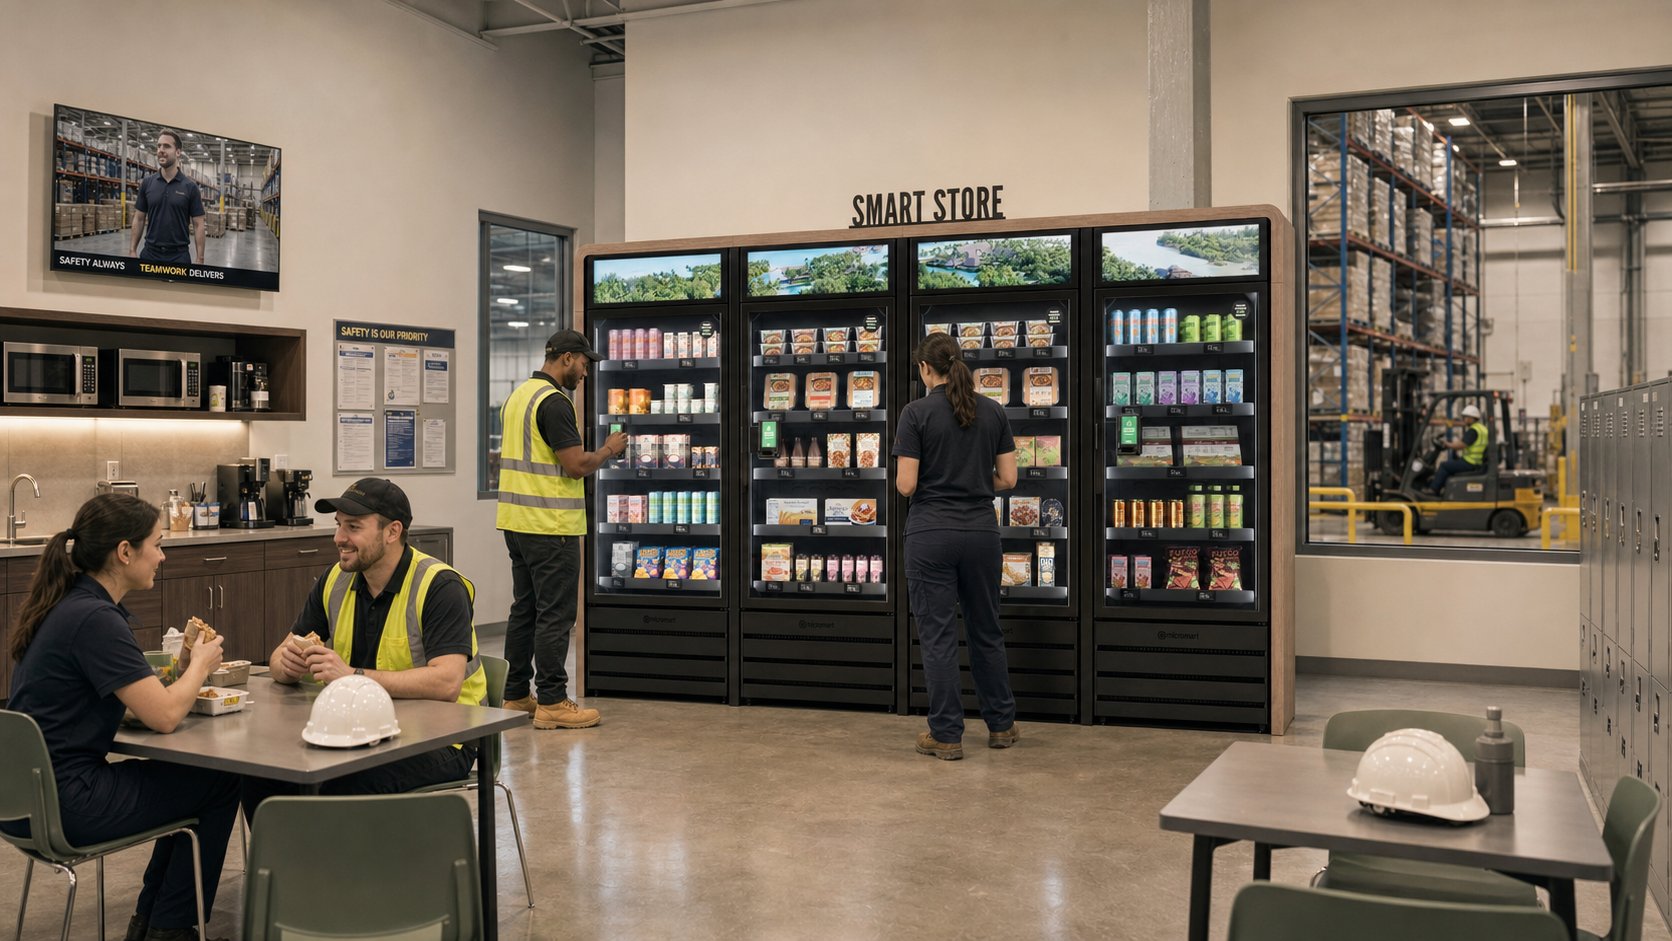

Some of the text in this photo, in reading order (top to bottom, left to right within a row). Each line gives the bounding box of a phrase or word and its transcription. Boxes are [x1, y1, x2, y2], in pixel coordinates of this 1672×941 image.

[852, 185, 1004, 228] SMART STORE
[59, 255, 224, 280] SAFETY ALWAYS TEAMWORK DELIVERS
[341, 326, 429, 342] SAFETY IS OUR PRIORITY
